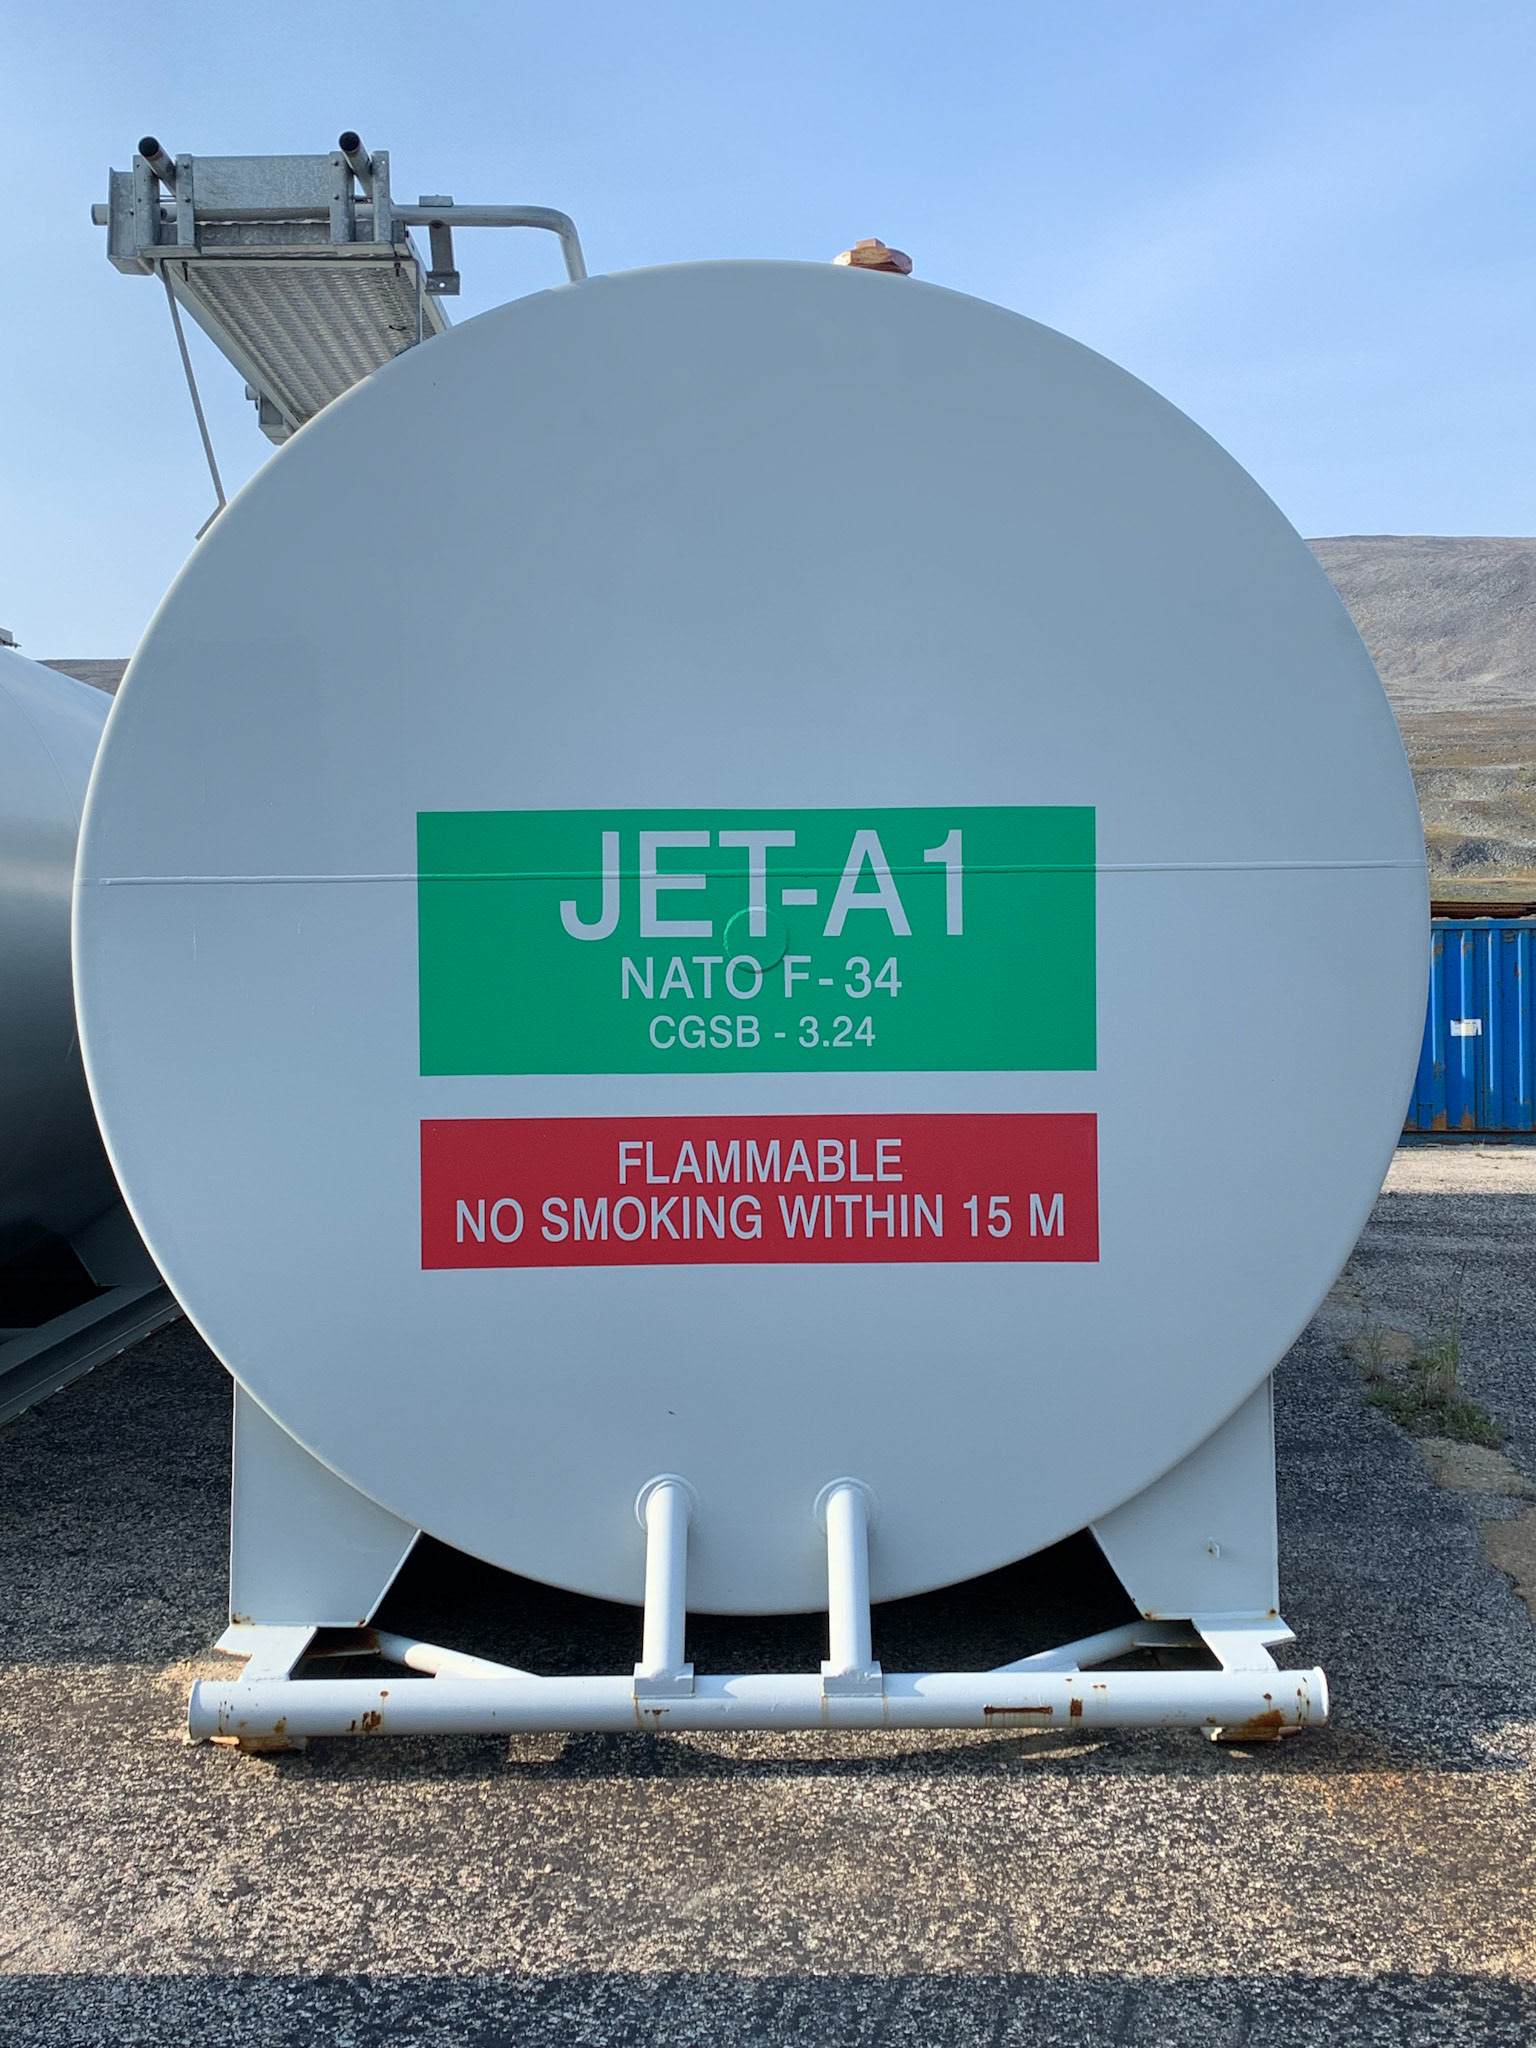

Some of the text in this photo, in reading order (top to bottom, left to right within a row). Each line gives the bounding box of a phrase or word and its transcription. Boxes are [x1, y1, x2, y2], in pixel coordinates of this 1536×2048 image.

[558, 828, 966, 942] JET-A1
[620, 954, 763, 1000] NATO
[648, 1014, 762, 1050] CGSB
[798, 1014, 877, 1048] 3.24
[617, 1137, 904, 1186] FLAMMABLE
[455, 1191, 1066, 1244] NO SMOKING WITHIN 15 M
